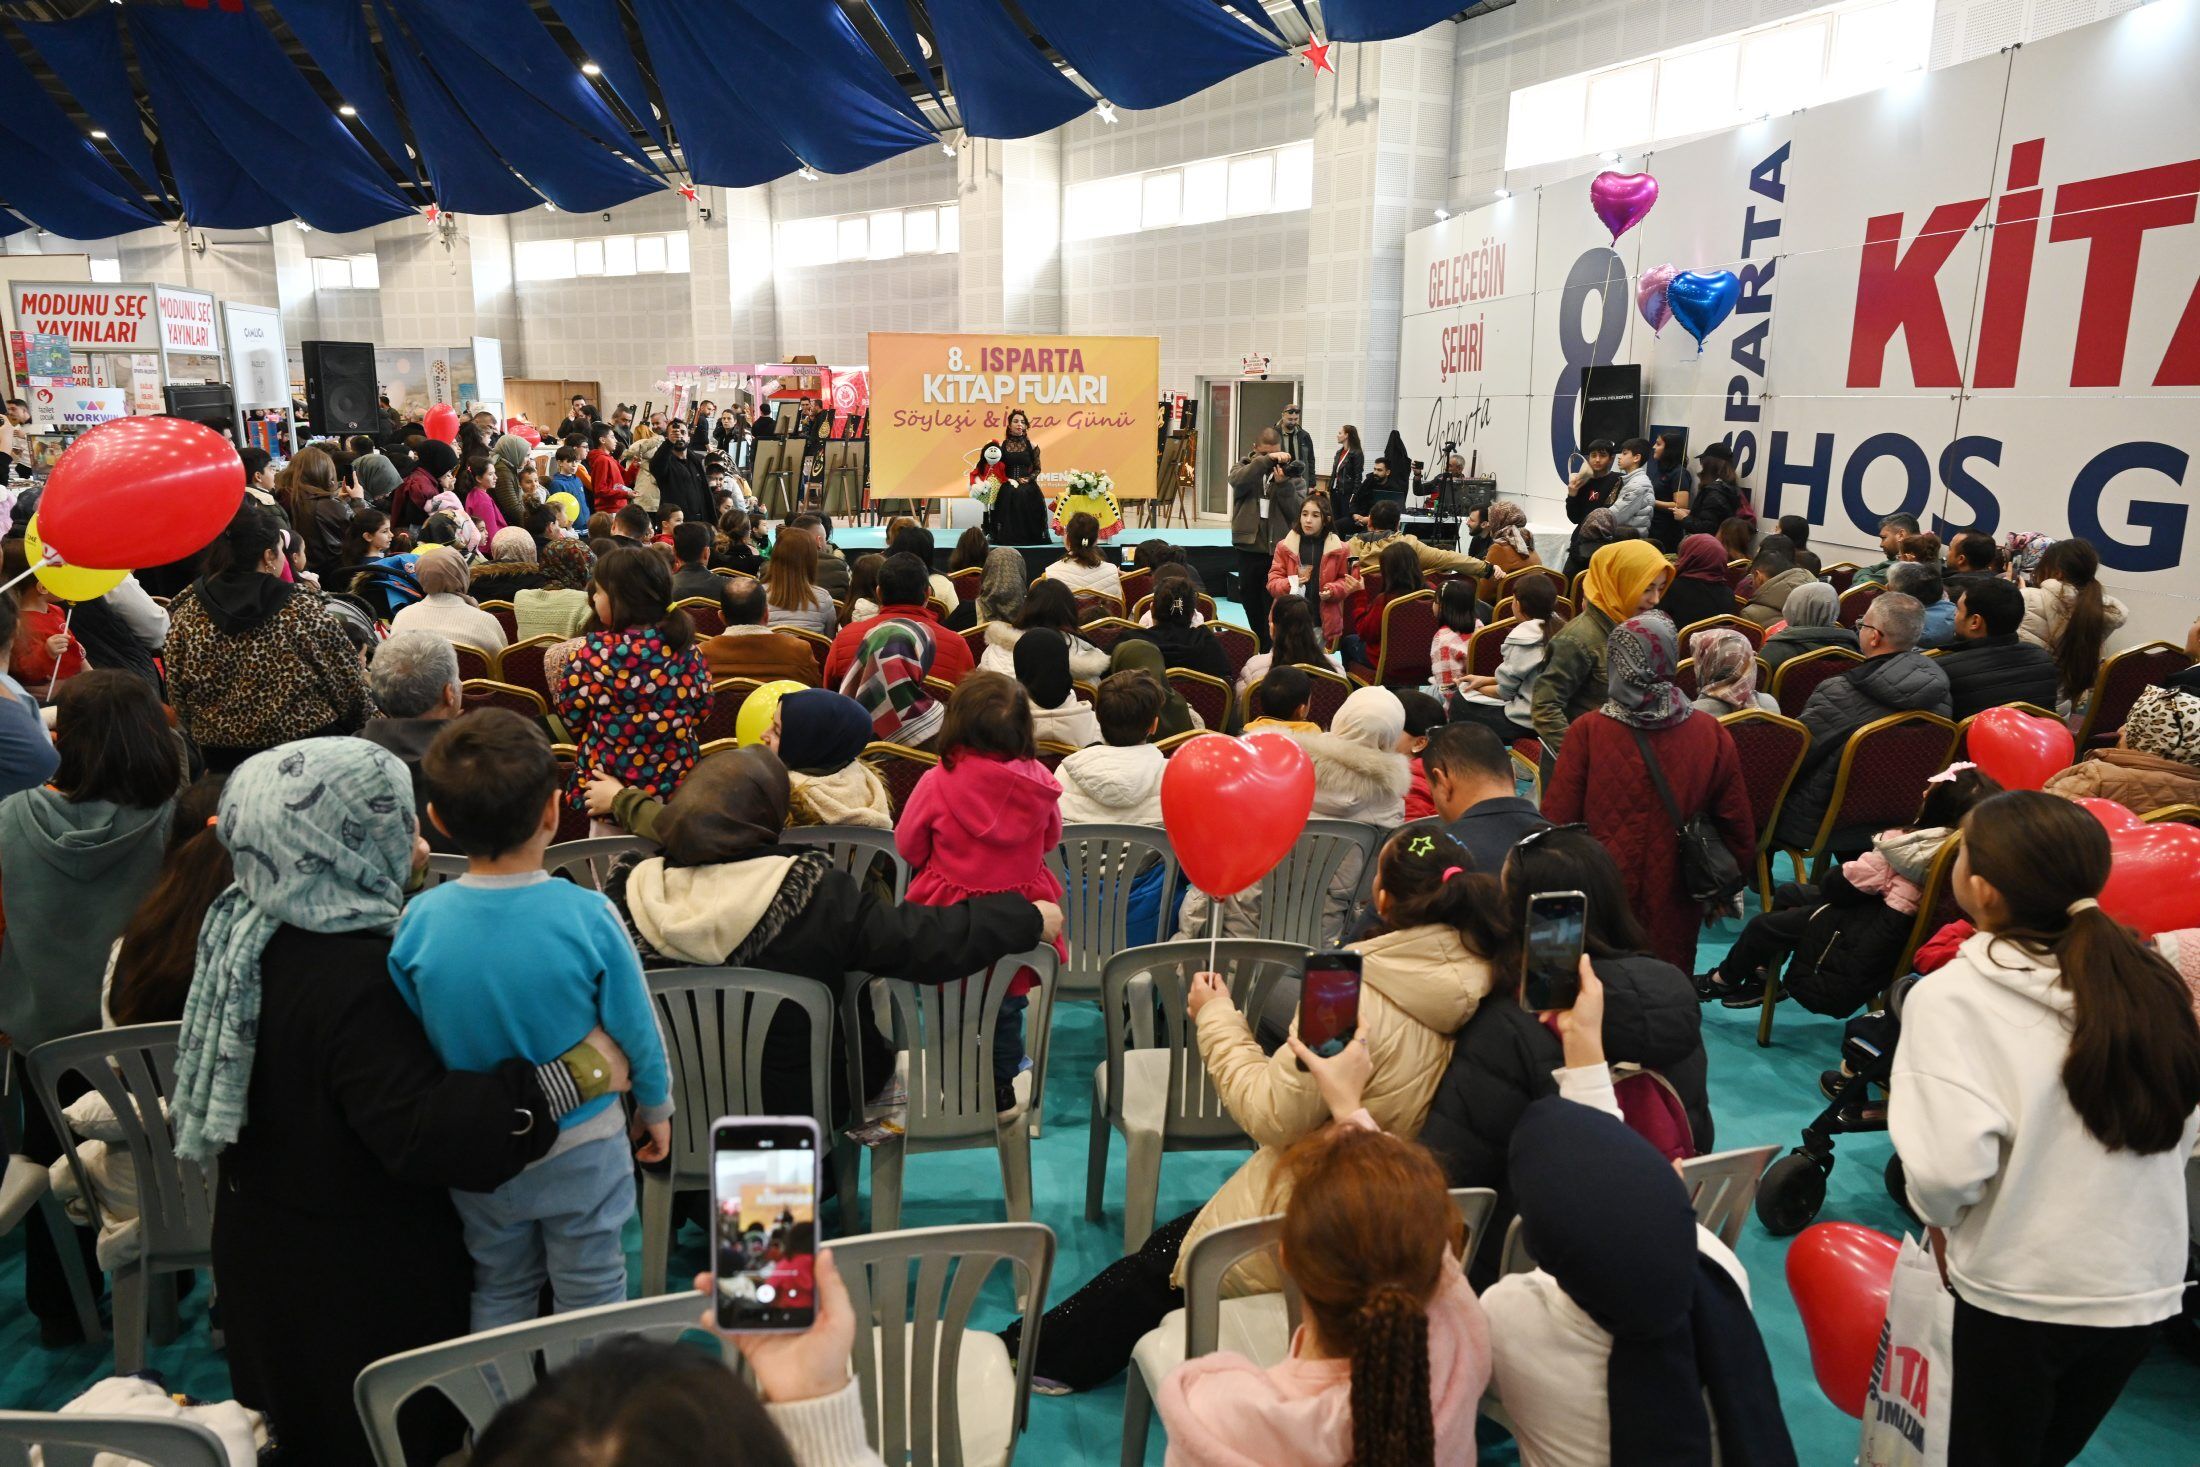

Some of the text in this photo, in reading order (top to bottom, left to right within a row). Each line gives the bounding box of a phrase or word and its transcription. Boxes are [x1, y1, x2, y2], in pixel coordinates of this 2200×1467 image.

[1428, 237, 1506, 309] GELECEĞİN
[21, 293, 148, 320] MODUNU SEÇ
[160, 297, 212, 326] MODUNU SEÇ
[37, 320, 138, 343] YAYINLARI
[167, 325, 209, 347] YAYINLARI
[1724, 139, 1791, 511] SPARTA
[948, 346, 1085, 373] 8. ISPARTA
[1441, 313, 1484, 383] ŞEHRİ
[923, 374, 1108, 404] KİTAP FUARI
[894, 405, 1136, 433] Söyleşi & İza Günü
